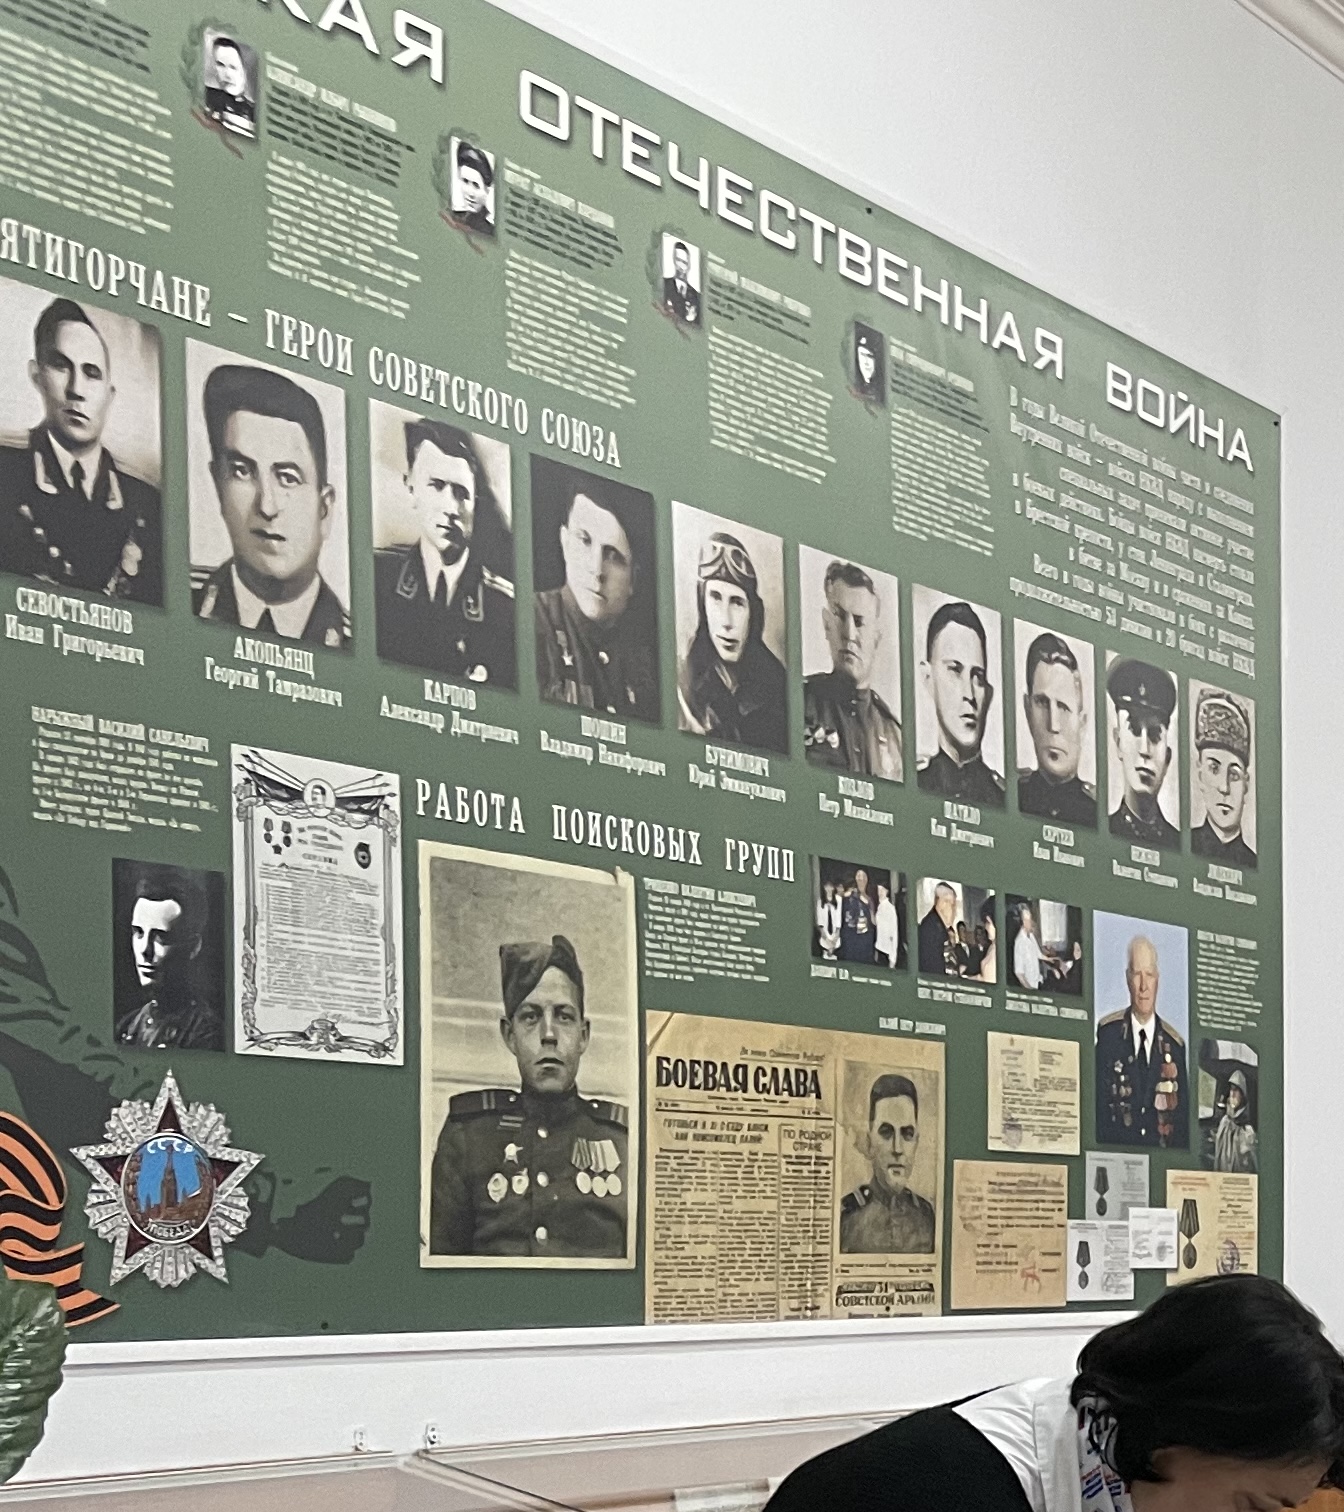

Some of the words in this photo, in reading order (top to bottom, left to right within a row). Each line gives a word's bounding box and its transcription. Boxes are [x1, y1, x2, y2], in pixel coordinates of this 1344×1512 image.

[518, 69, 1065, 379] ОТЕЧЕСТВЕННАЯ
[1106, 361, 1254, 472] ВОЙНА
[264, 308, 354, 376] ГЕРОИ
[368, 345, 529, 436] СОВЕТСКОГО
[540, 407, 622, 469] СОЮЗА
[16, 586, 134, 635] СЕВОСТЬЯНОВ
[415, 778, 527, 834] РАБОТА
[551, 804, 703, 866] ПОИСКОВЫХ
[724, 837, 796, 883] ГРУПП
[656, 1055, 749, 1094] БОЕВАЯ
[753, 1065, 822, 1100] СЛАВА
